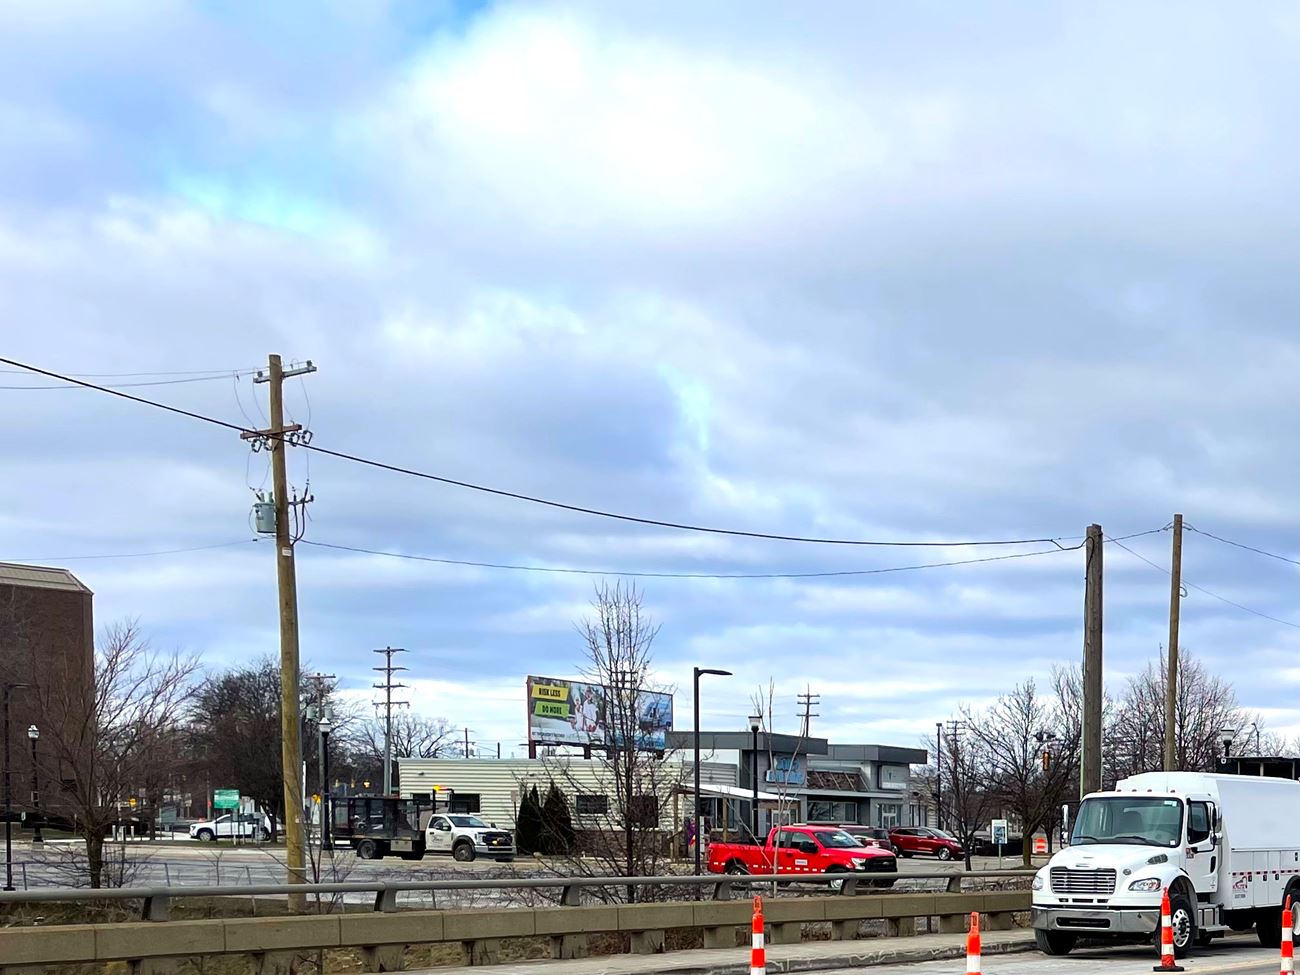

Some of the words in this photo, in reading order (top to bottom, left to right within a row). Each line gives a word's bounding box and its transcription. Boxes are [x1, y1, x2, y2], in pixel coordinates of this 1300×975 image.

[550, 689, 560, 697] LESS
[542, 705, 549, 713] DO
[550, 706, 562, 714] MORE
